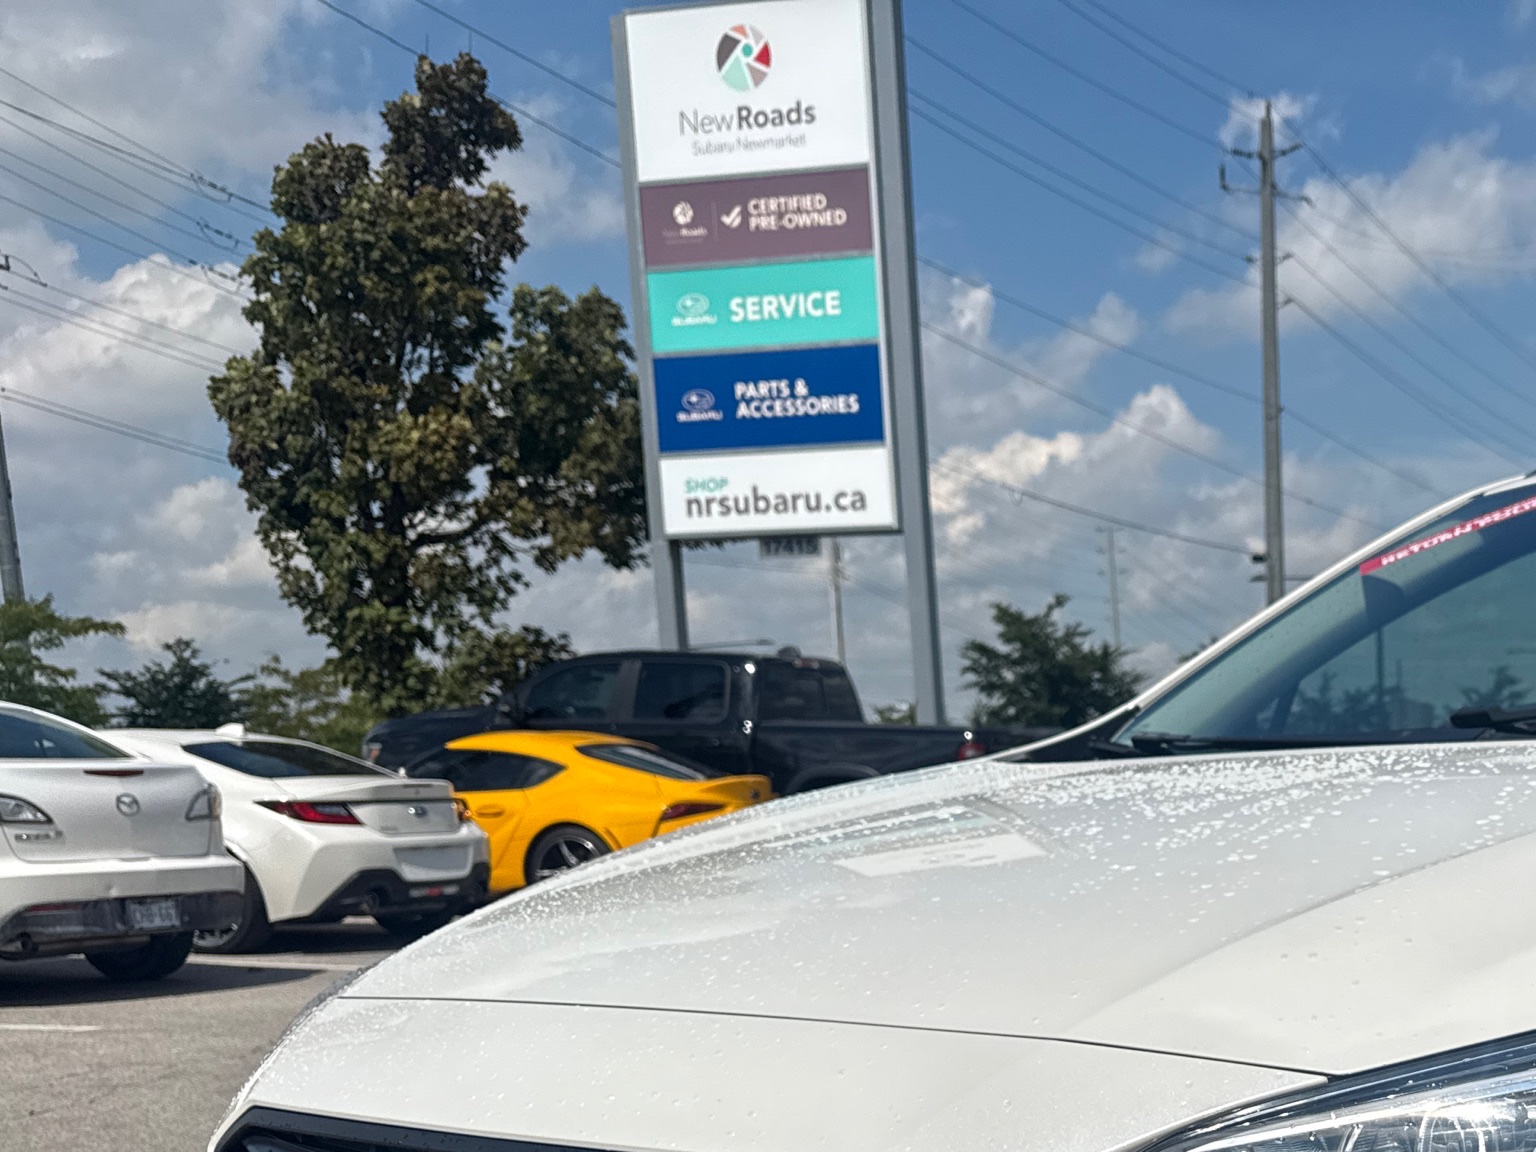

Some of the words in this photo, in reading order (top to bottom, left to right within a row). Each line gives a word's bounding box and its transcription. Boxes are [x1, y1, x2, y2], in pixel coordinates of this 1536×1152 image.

[691, 140, 735, 157] Subaru
[736, 133, 806, 152] Newmarket
[747, 193, 828, 214] CERTIFIED
[748, 208, 847, 231] PRE-OWNED
[729, 290, 842, 323] SERVICE
[734, 378, 790, 401] PARTS
[794, 377, 809, 397] &
[735, 393, 860, 420] ACCESSORIES
[684, 476, 729, 494] SHOP
[685, 484, 867, 519] nrsubaru.ca
